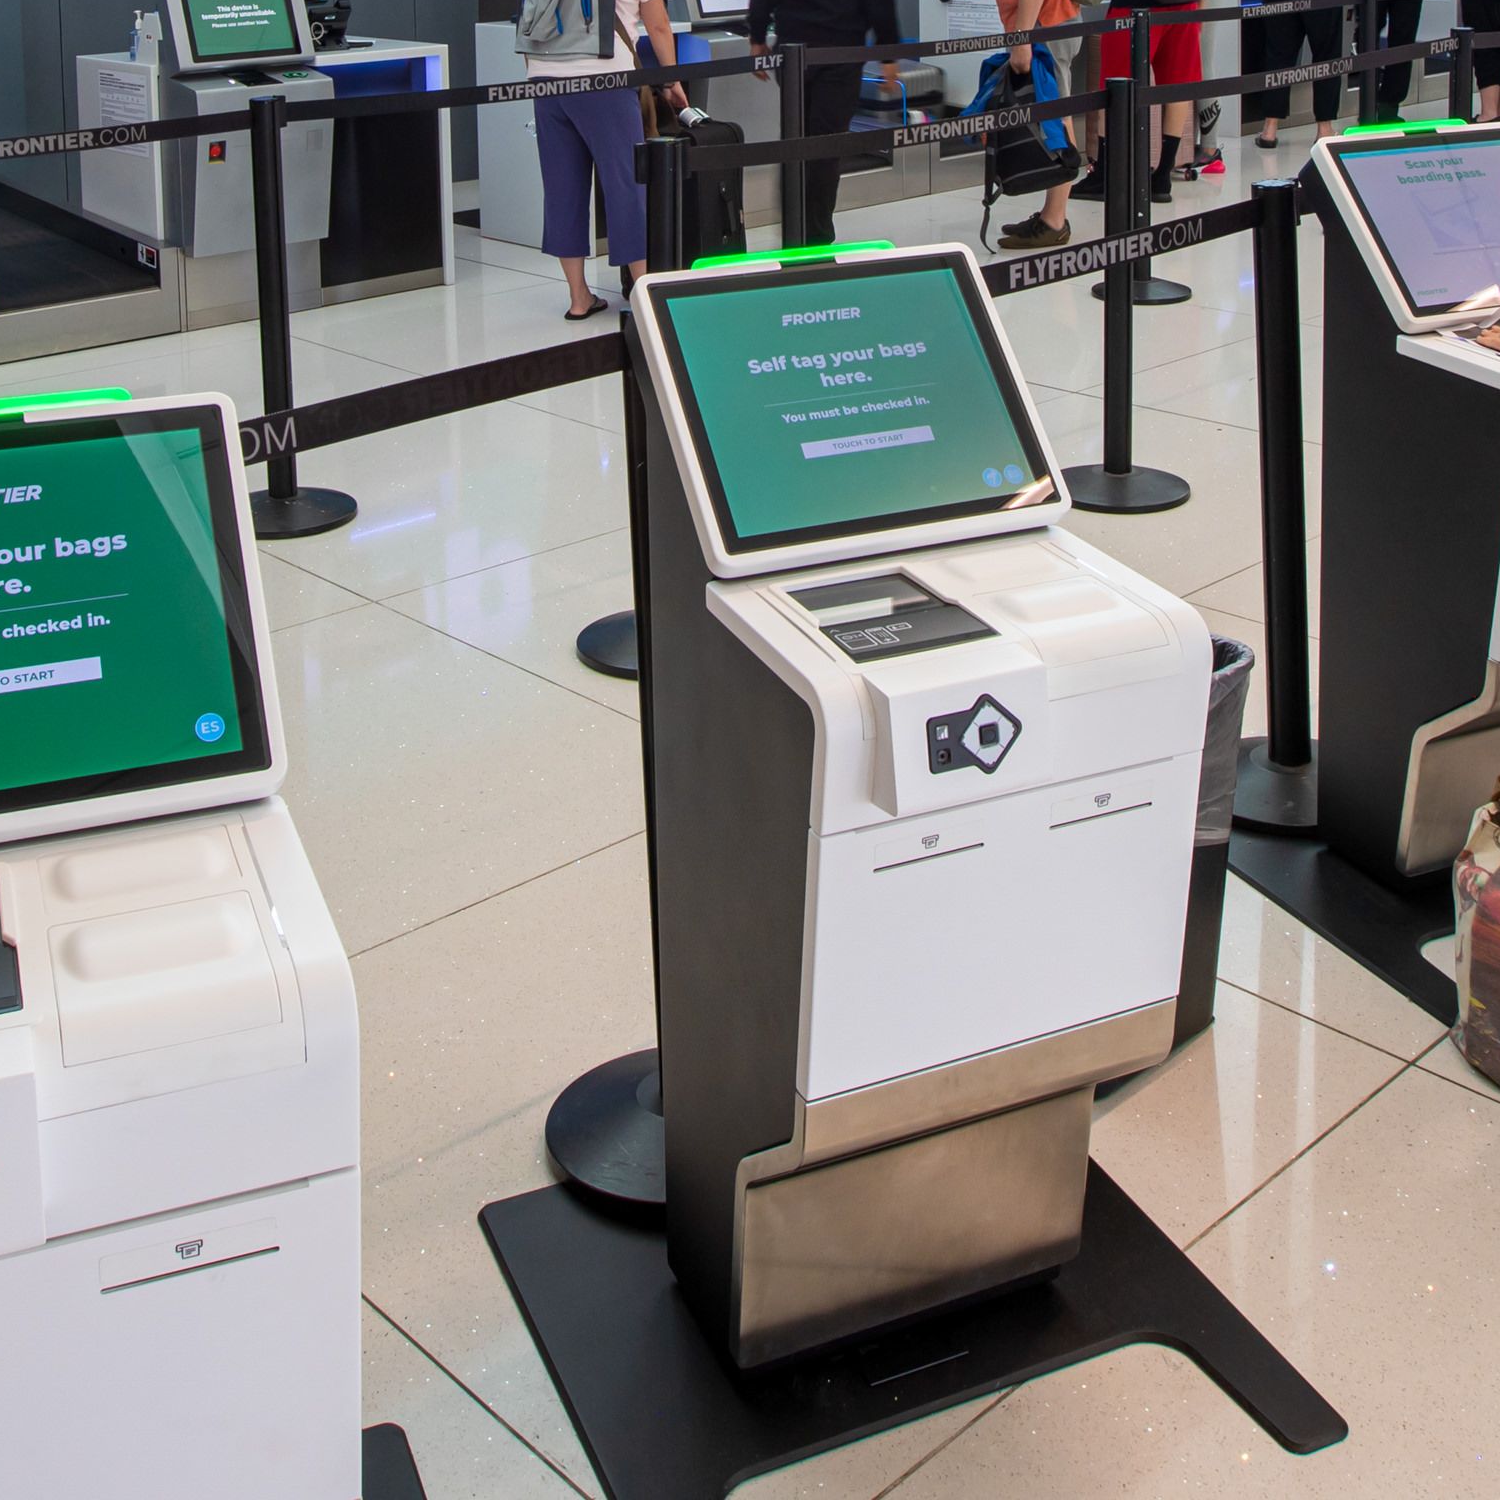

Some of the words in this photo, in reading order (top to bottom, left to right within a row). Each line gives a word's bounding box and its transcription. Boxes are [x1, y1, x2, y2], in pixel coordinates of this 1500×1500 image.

[1243, 0, 1312, 18] FLYFRONTIER.COM
[935, 32, 1030, 54] FLYFRONTIER.COM
[1265, 58, 1353, 88] FLYFRONTIER.COM
[488, 73, 628, 102] FLYFRONTIER.COM
[1201, 100, 1221, 126] NIKE
[893, 107, 1031, 147] FLYFRONTIER.COM
[1404, 159, 1434, 170] Scan
[1436, 156, 1464, 169] your
[1397, 171, 1454, 185] boarding
[1456, 169, 1486, 181] pass.
[1009, 219, 1203, 289] FLYFRONTIER.COM
[782, 307, 861, 326] FRONTIER
[748, 355, 787, 374] Self
[791, 353, 826, 369] tag
[830, 347, 874, 367] your
[878, 341, 927, 358] bags
[820, 370, 873, 388] here.
[781, 413, 806, 424] You
[809, 409, 841, 420] must
[843, 406, 859, 415] be
[861, 396, 913, 414] checked
[913, 395, 930, 405] in.
[832, 439, 863, 450] TOUCH
[864, 437, 876, 445] TO
[878, 433, 904, 444] START
[54, 534, 128, 558] bags
[2, 615, 83, 639] checked
[87, 613, 111, 627] in.
[14, 669, 56, 684] START
[201, 721, 220, 734] ES
